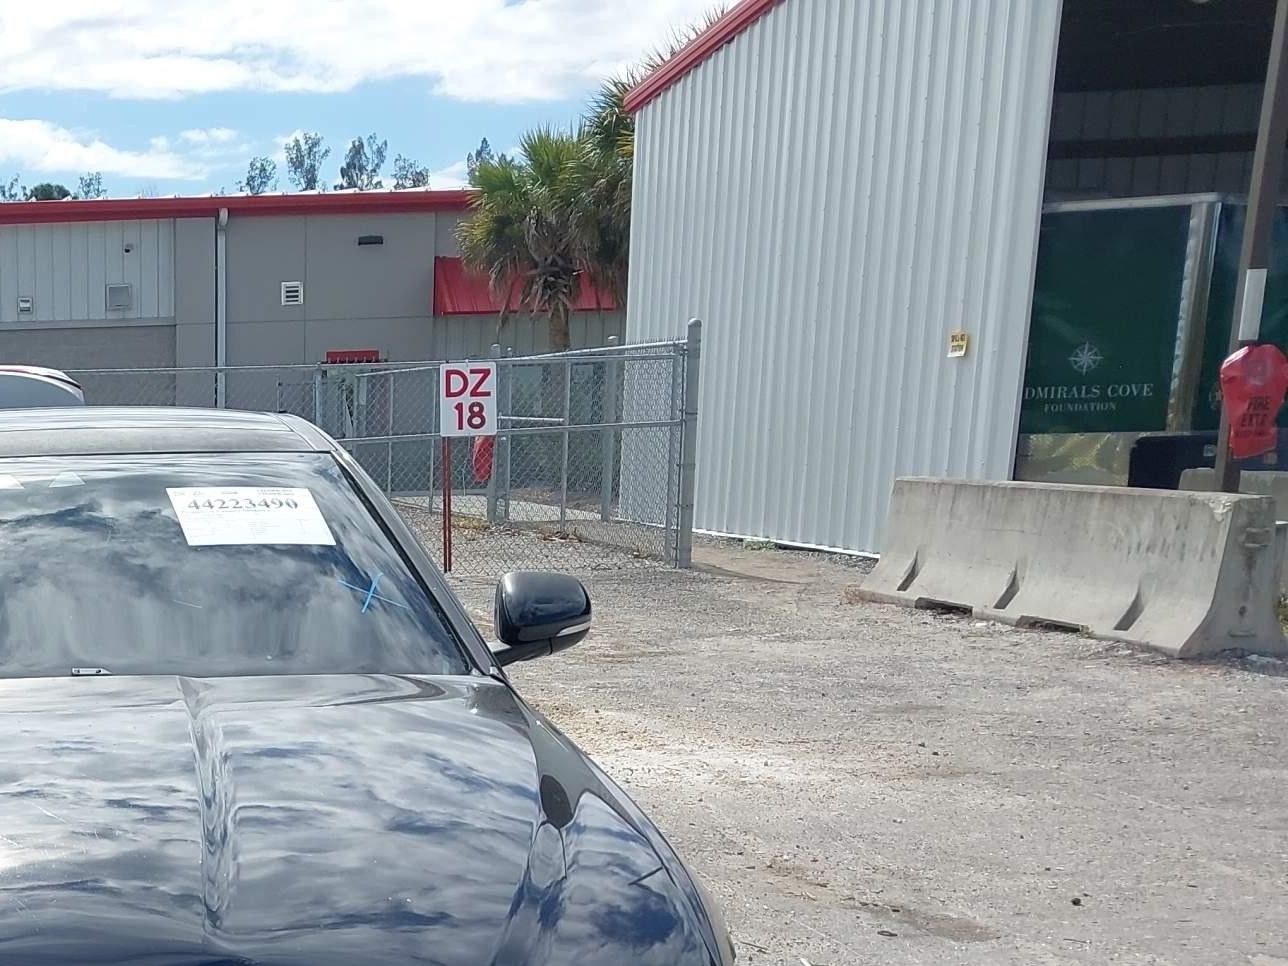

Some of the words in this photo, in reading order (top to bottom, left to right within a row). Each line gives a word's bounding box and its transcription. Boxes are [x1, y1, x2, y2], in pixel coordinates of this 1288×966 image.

[445, 368, 492, 398] DZ
[1023, 385, 1101, 400] DMIRALS
[1107, 383, 1154, 398] COVE
[454, 401, 486, 430] 18
[1043, 401, 1117, 413] FOUNDATION
[187, 498, 299, 510] 44223490
